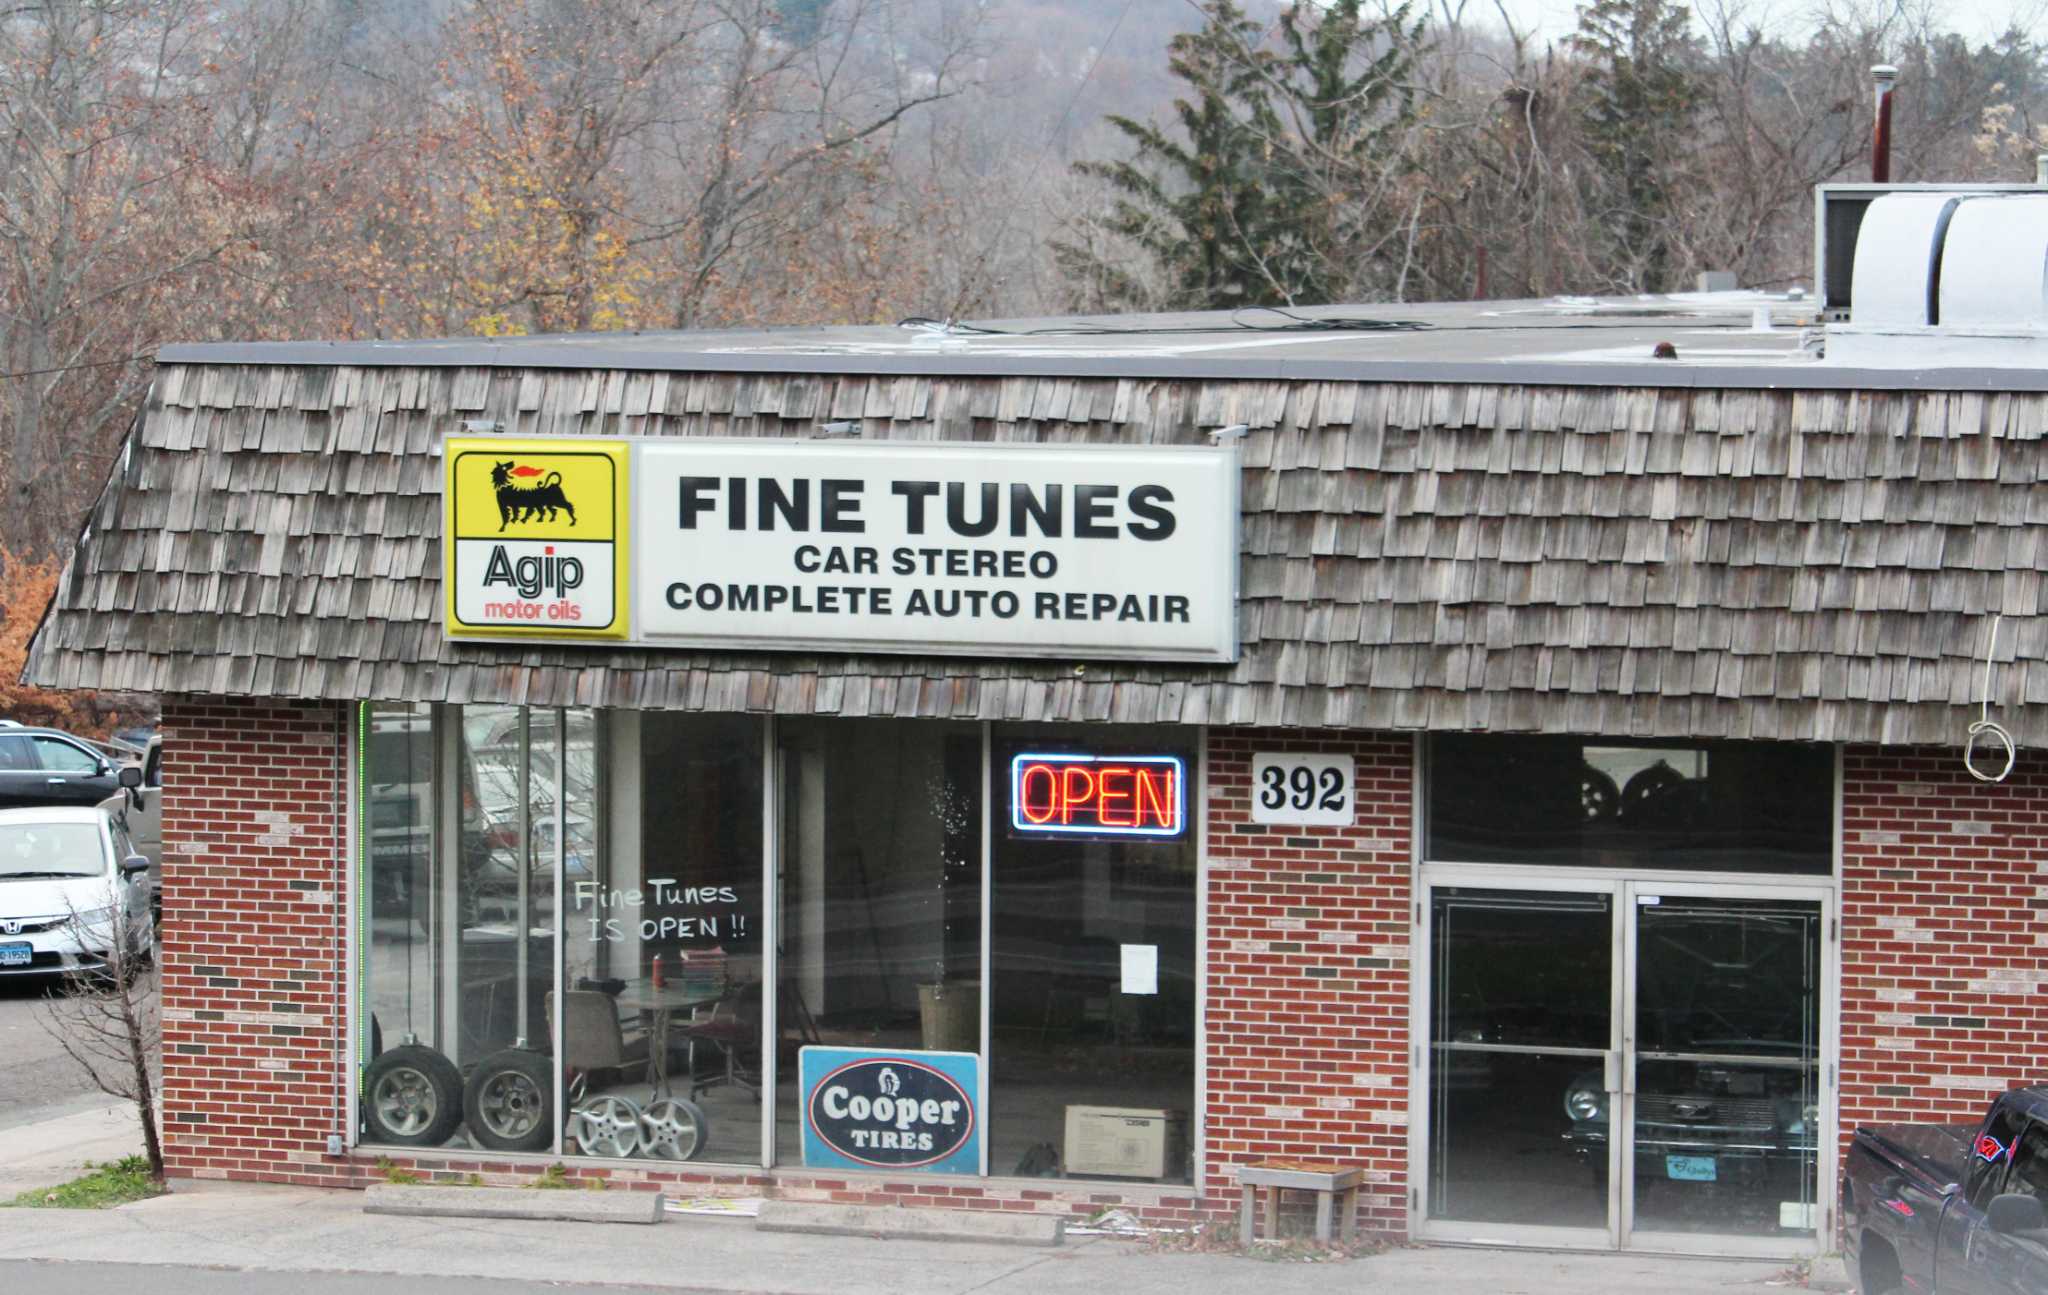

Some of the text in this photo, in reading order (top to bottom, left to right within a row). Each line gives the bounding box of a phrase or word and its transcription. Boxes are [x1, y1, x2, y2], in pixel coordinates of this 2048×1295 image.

[679, 477, 1178, 542] FINE TUNES
[482, 544, 584, 599] Agip
[794, 545, 1058, 579] CAR STEREO
[484, 599, 582, 620] motor oils
[665, 582, 1190, 623] COMPLETE AUTO REPAIR
[1022, 764, 1176, 828] OPEN
[1260, 765, 1345, 812] 392
[574, 878, 738, 910] Fine Tunes
[587, 918, 625, 942] IS
[639, 916, 718, 940] OPEN
[823, 1085, 960, 1130] Cooper
[851, 1129, 933, 1151] TIRES
